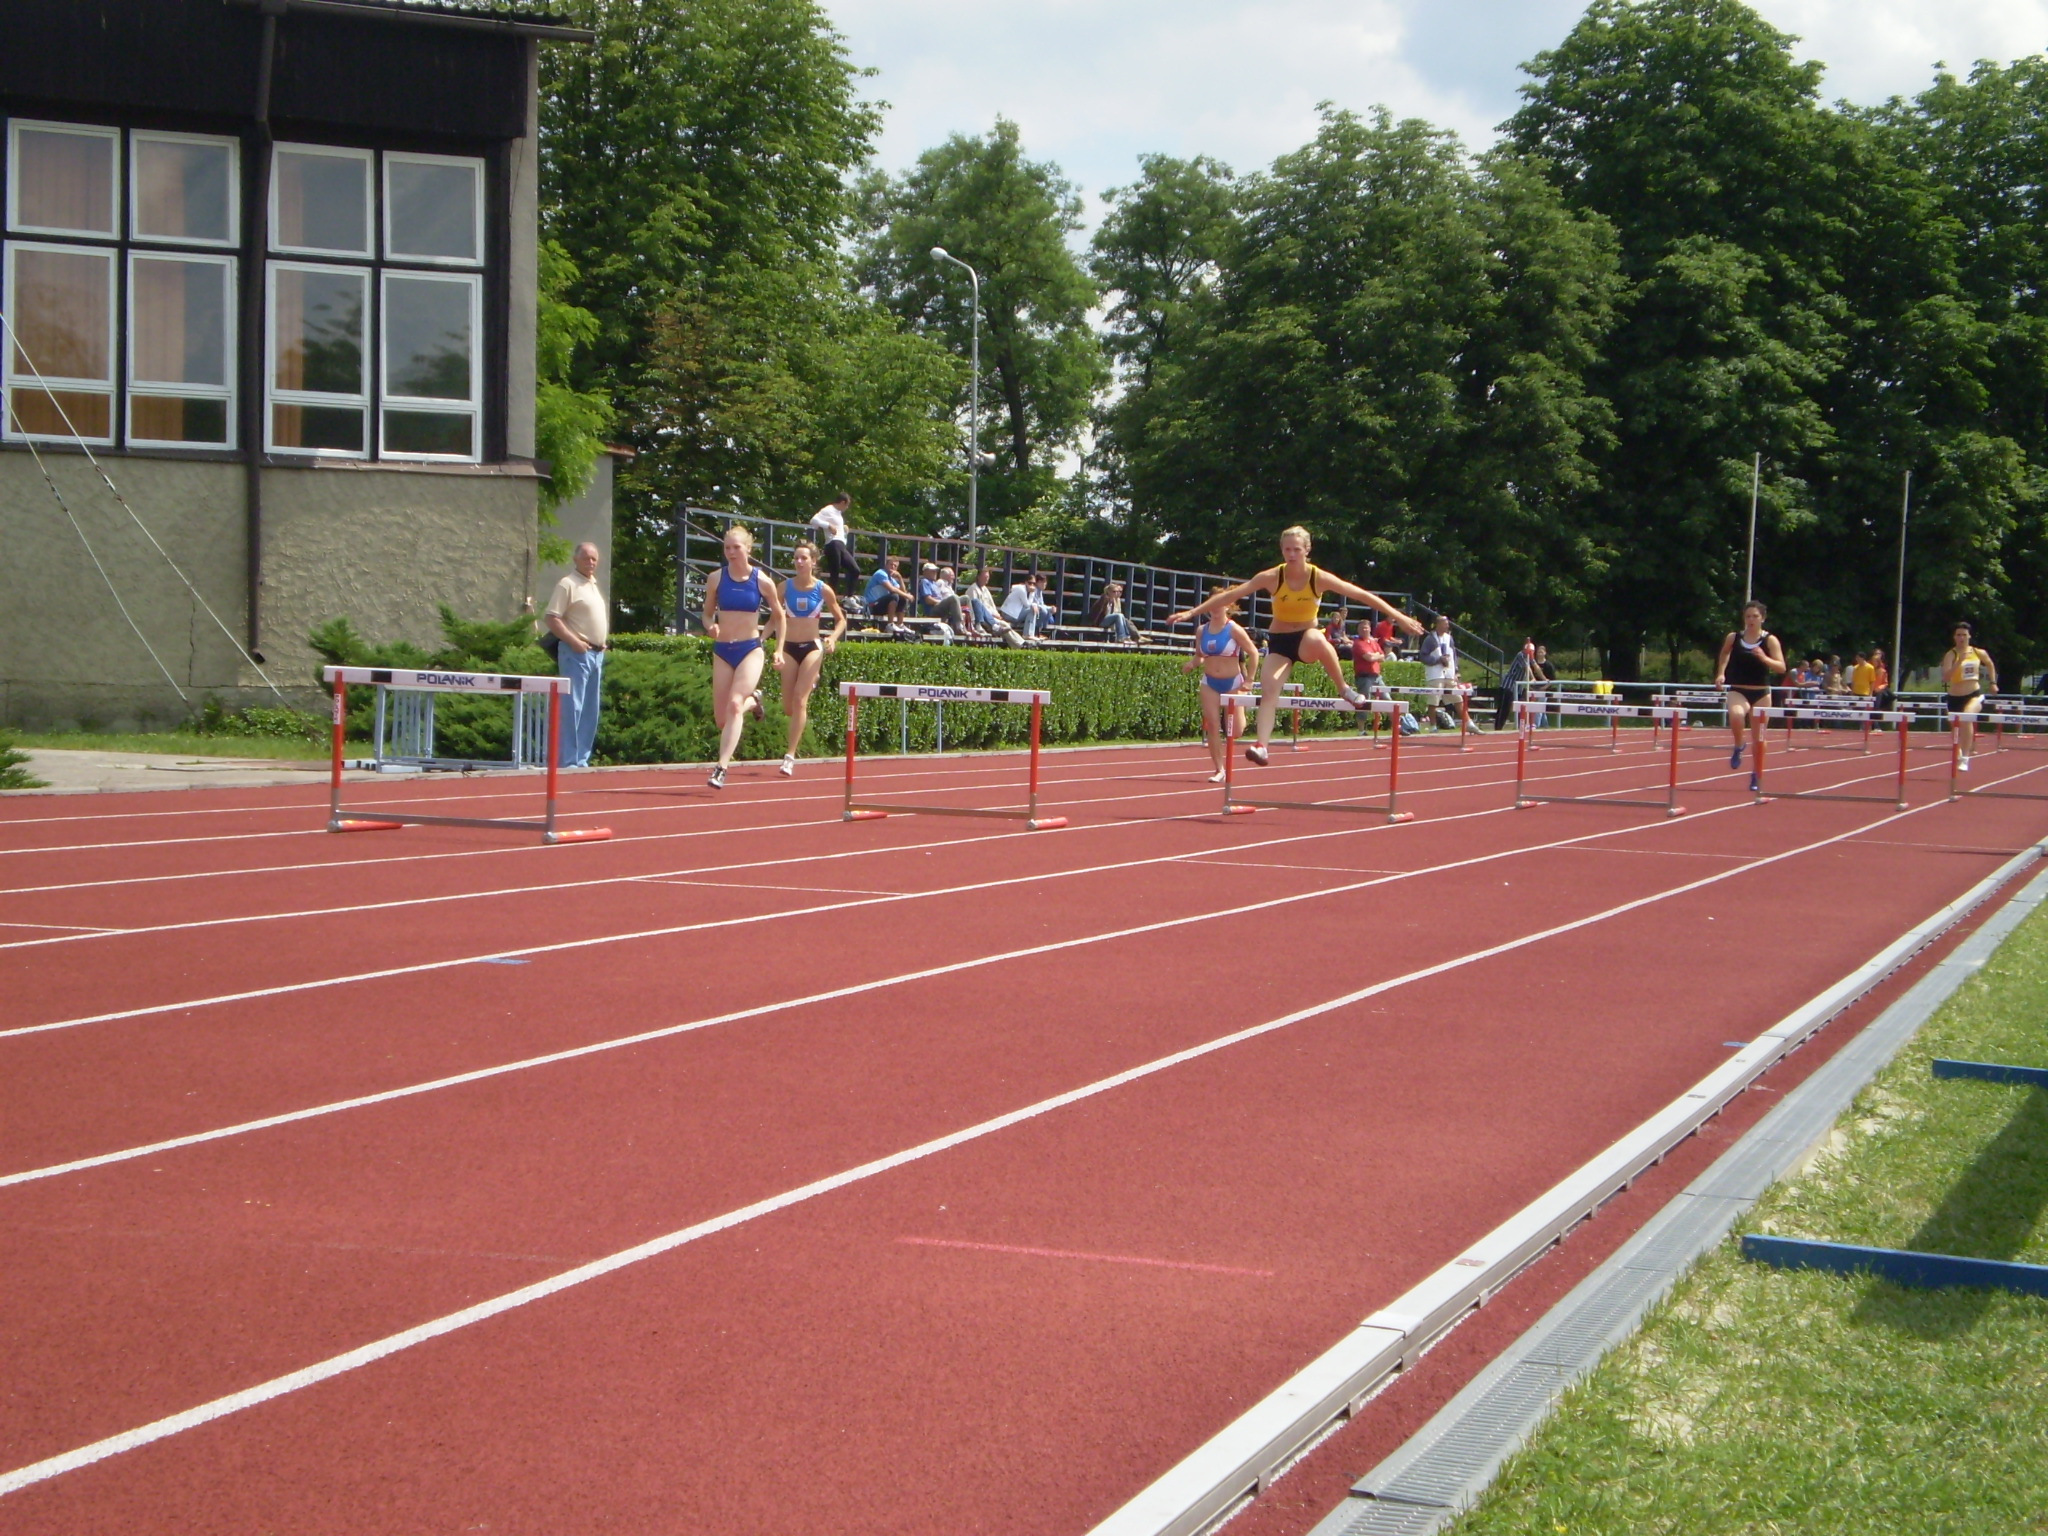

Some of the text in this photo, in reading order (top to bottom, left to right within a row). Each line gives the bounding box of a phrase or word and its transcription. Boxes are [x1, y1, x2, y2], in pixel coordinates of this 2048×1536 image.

[918, 688, 968, 699] POLANIK
[1290, 699, 1336, 708] POLANIK
[1577, 706, 1620, 714] POLANIK
